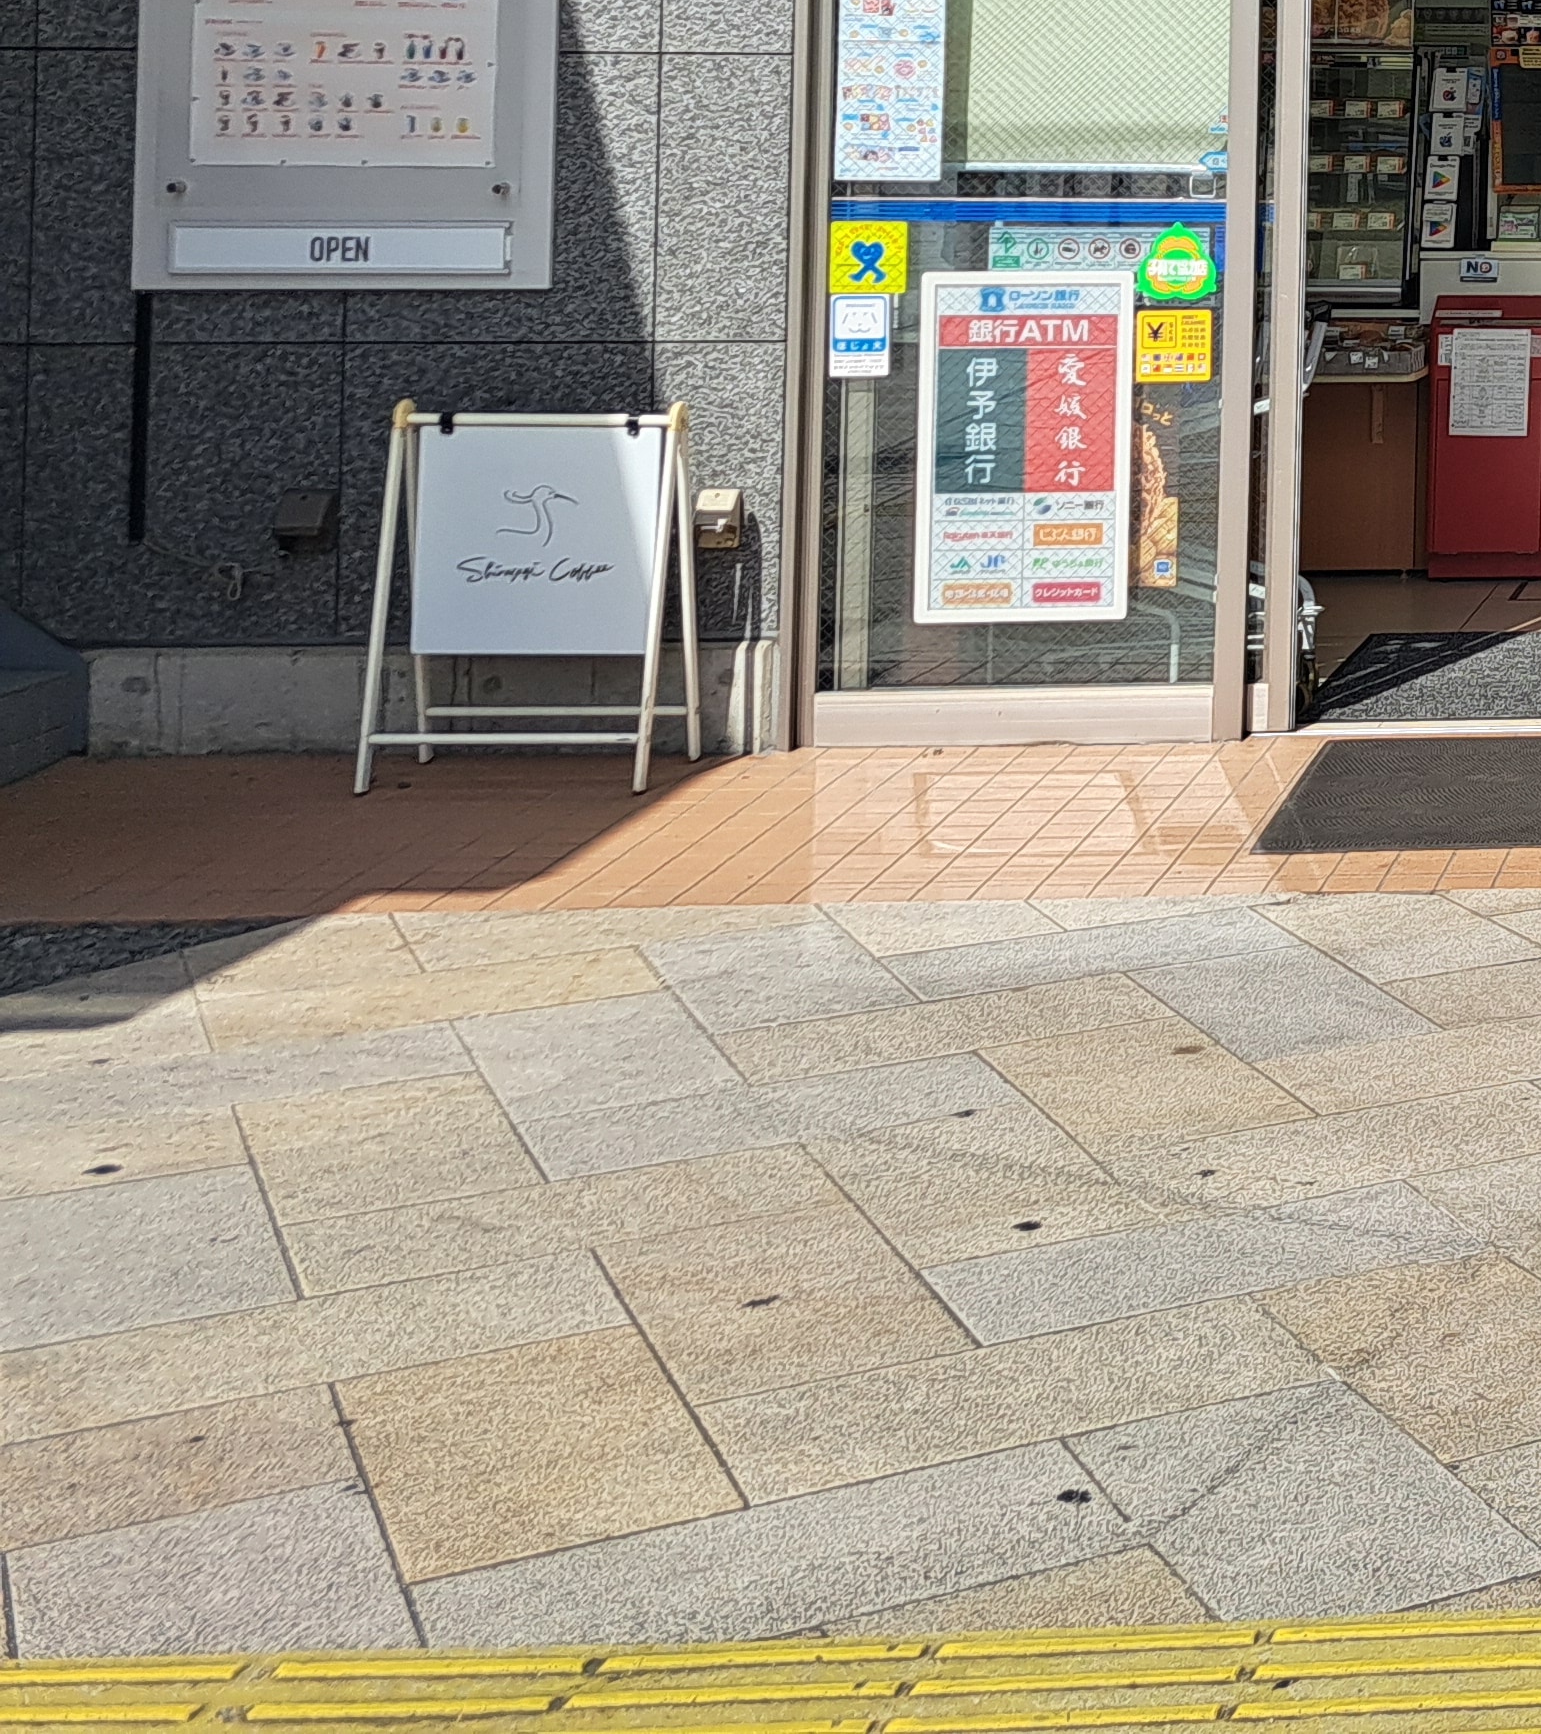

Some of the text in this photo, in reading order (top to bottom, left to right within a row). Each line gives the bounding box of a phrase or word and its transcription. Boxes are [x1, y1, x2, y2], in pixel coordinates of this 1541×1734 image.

[309, 237, 370, 263] OPEN
[1009, 290, 1080, 302] ローソン銀行
[968, 319, 1089, 343] 銀行ATM
[965, 357, 998, 484] 伊予銀行
[1054, 354, 1087, 486] 愛媛銀行
